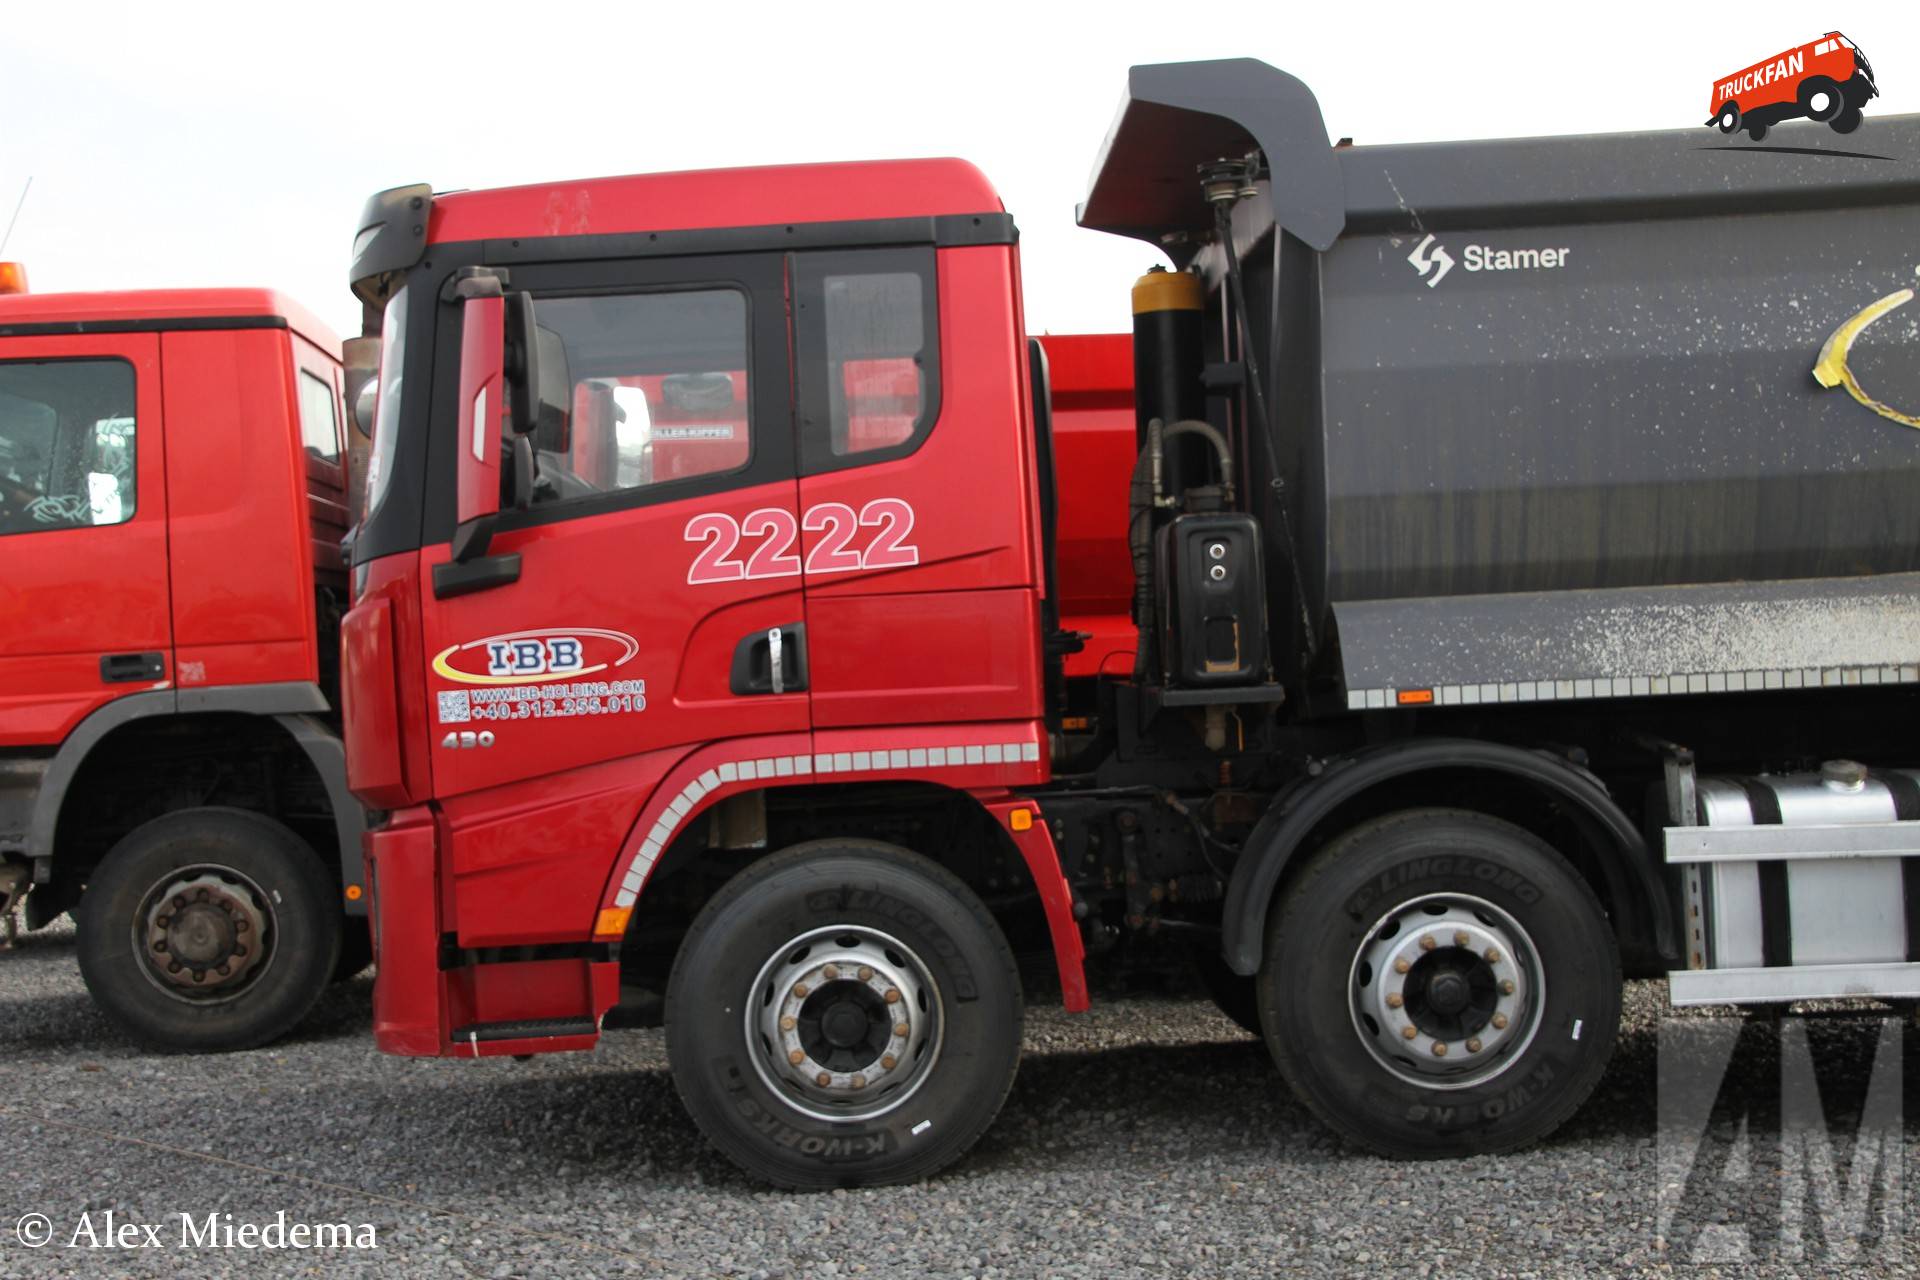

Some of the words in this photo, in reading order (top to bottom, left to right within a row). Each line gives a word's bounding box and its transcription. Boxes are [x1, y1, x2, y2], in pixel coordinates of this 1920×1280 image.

[1463, 244, 1570, 272] Stamer
[684, 498, 919, 585] 2222
[488, 637, 584, 676] IBB
[471, 695, 647, 720] +40.312.255.010
[441, 730, 495, 749] 430
[1380, 857, 1539, 903] LINGLONG
